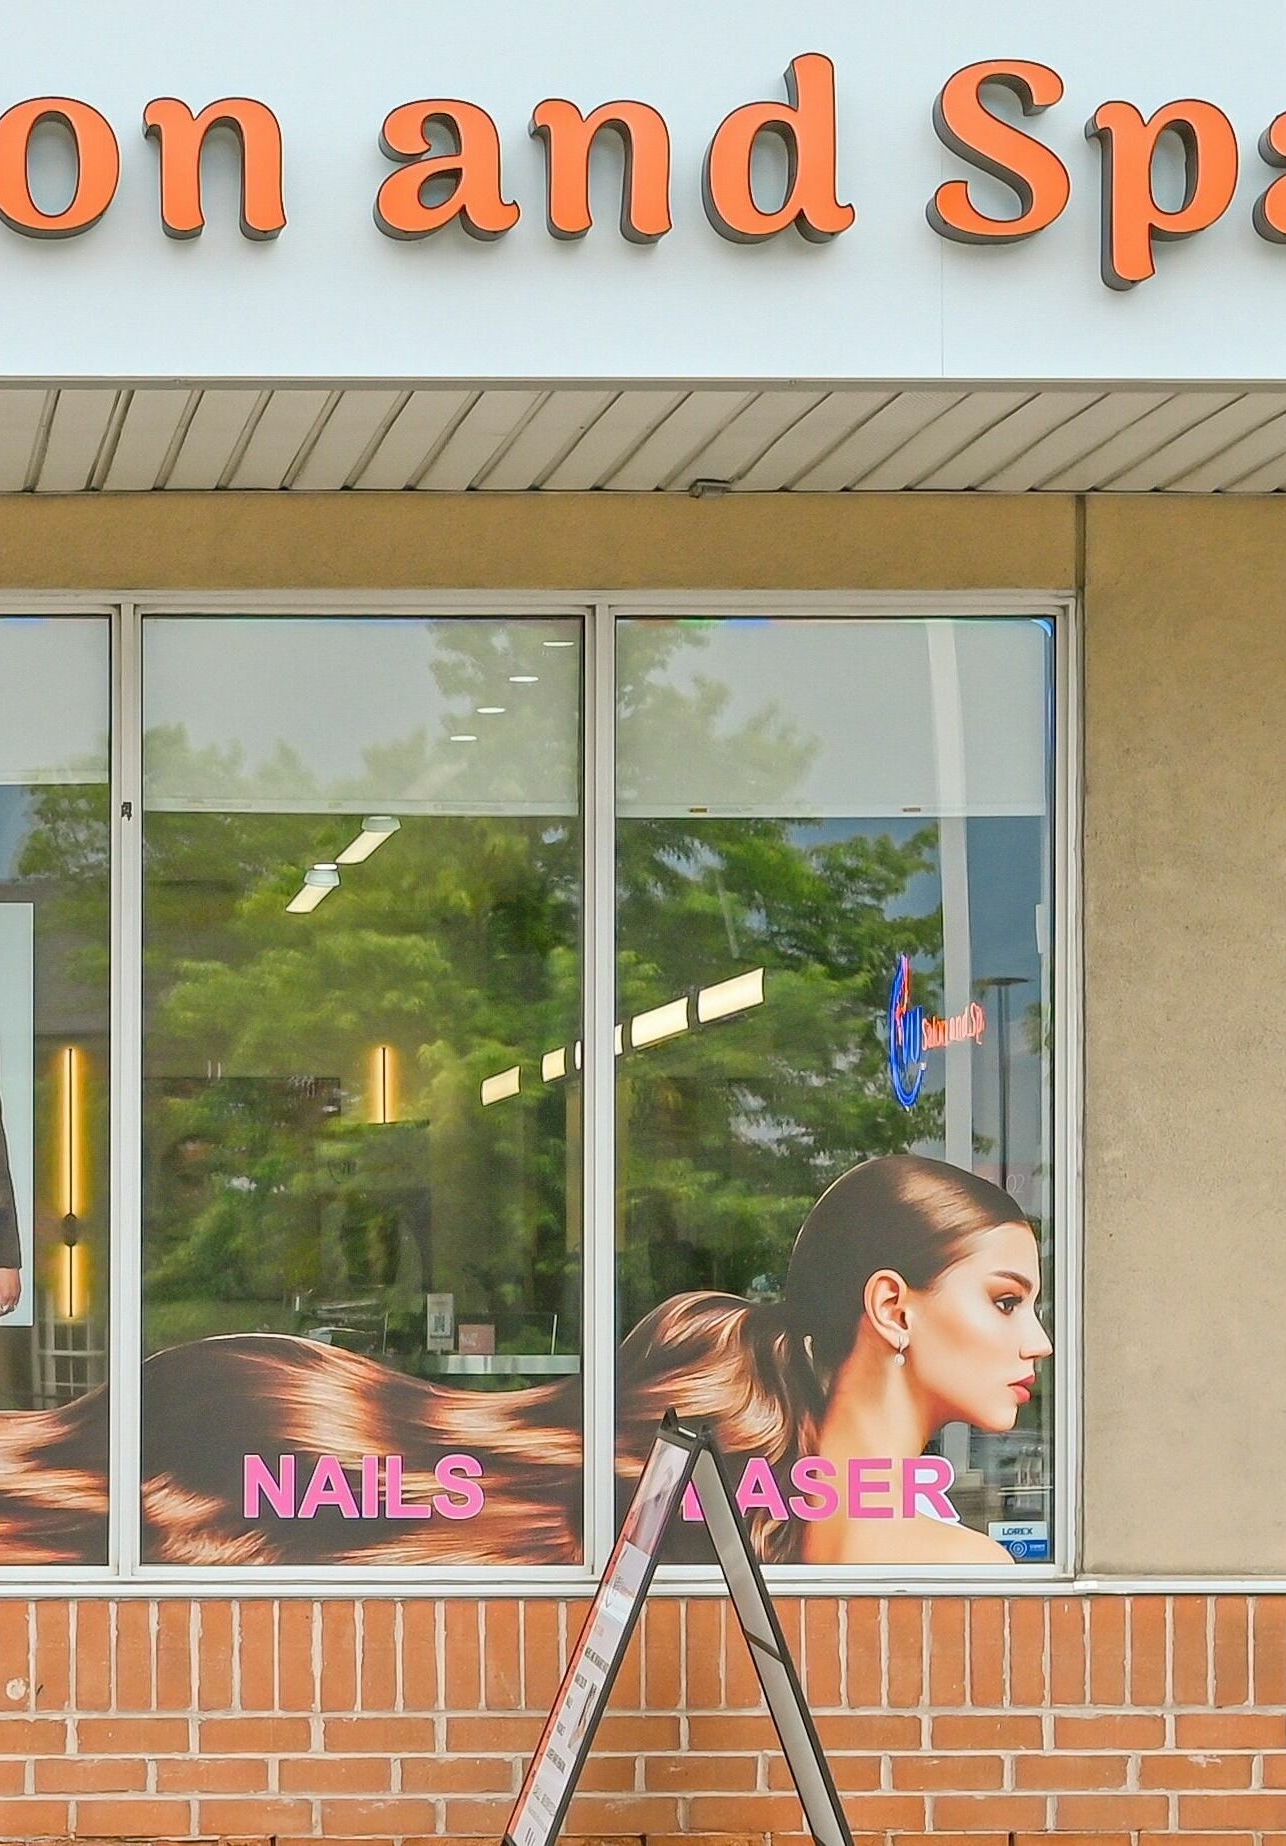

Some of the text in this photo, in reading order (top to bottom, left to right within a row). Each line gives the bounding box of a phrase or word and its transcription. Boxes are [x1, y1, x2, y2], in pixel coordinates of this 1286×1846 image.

[374, 53, 856, 244] and
[926, 58, 1286, 292] Sp
[241, 1453, 485, 1520] NAILS
[1001, 1527, 1034, 1536] LOREX
